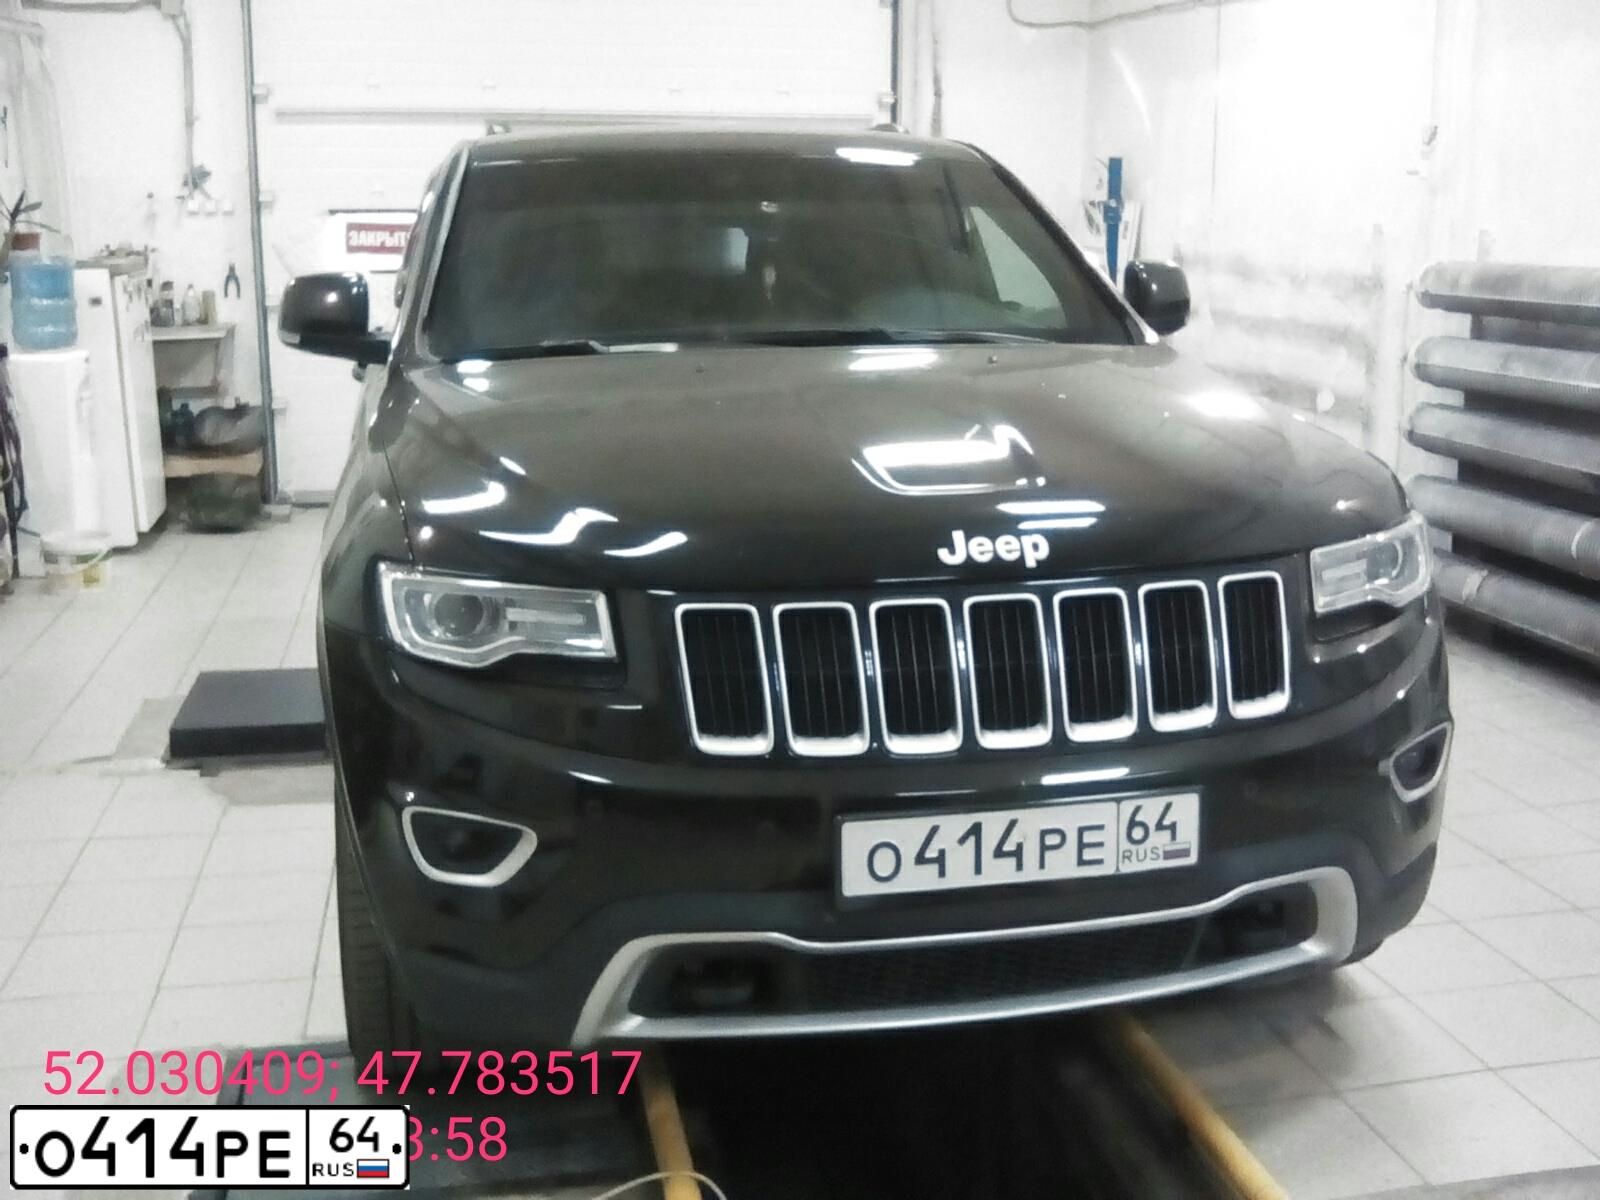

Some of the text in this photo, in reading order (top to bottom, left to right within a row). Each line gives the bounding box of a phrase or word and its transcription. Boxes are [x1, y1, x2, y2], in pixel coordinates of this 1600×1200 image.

[937, 529, 1049, 568] Jeep
[867, 802, 1178, 883] О414РЕ 64
[1121, 846, 1161, 864] RUS
